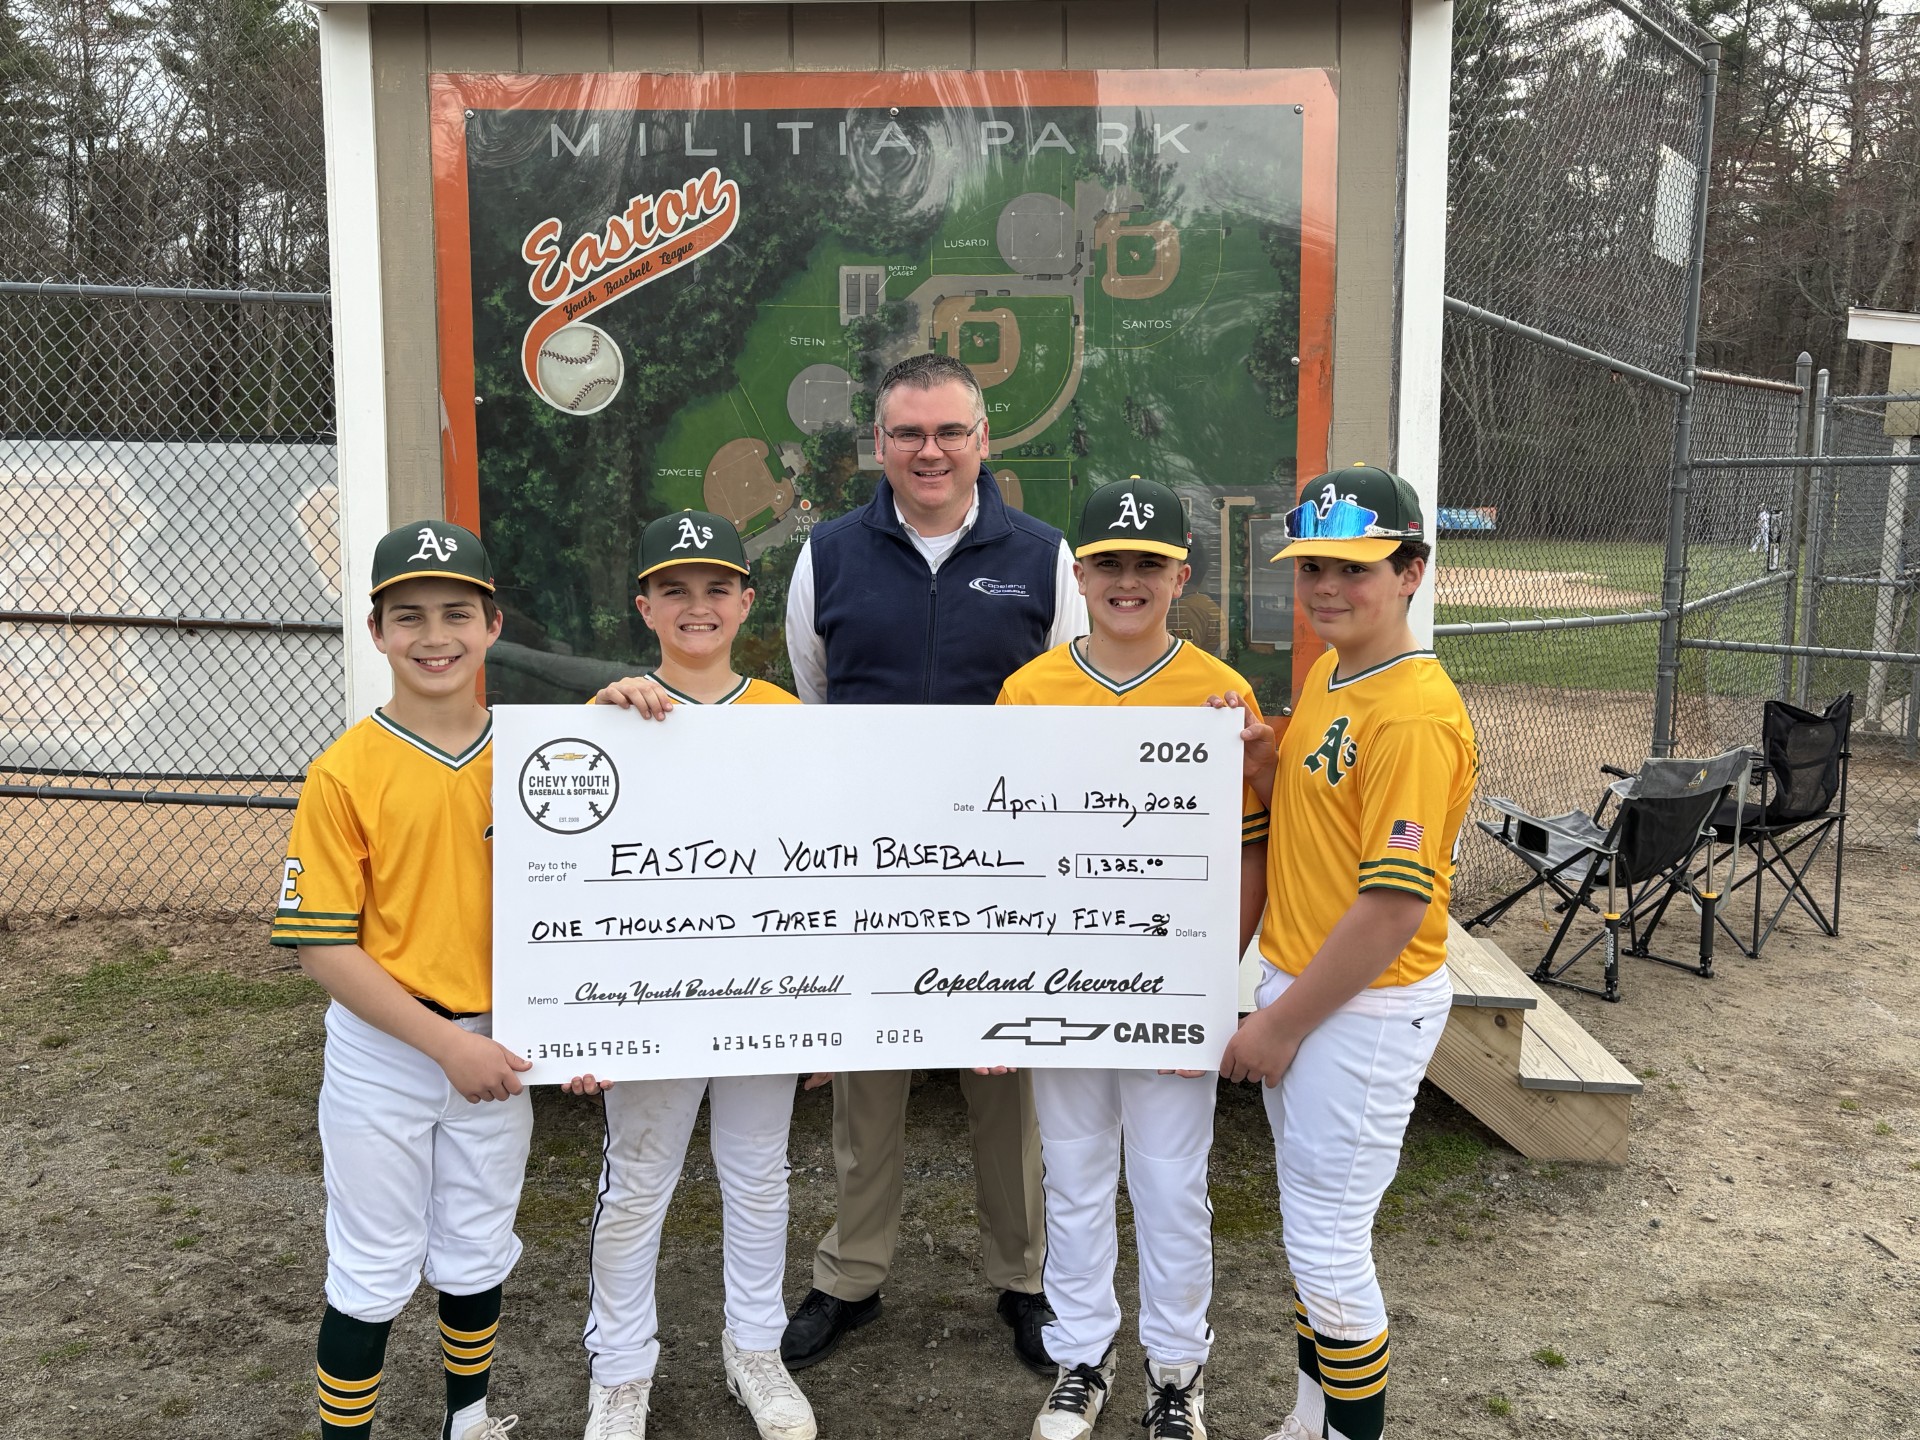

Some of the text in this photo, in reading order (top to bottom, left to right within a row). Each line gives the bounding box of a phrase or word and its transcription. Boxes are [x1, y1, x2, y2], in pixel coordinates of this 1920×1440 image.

[550, 120, 1191, 158] MILITIA PARK
[521, 166, 740, 306] Easton
[943, 238, 990, 249] LUSARDI
[562, 241, 695, 322] Youth Baseball League
[1121, 318, 1173, 330] SANTOS
[789, 336, 826, 347] STEIN
[987, 402, 1011, 413] LEY
[657, 468, 703, 478] JAYCEE
[794, 515, 820, 524] YOU
[794, 524, 813, 533] AR
[981, 581, 1026, 590] Copeland
[1139, 742, 1209, 763] 2026
[528, 775, 610, 788] CHEVY YOUTH
[528, 788, 609, 796] BASEBALL & SOFTBALL
[953, 803, 975, 813] Date
[987, 775, 1198, 828] April 13th, 2026
[610, 836, 1025, 877] EASTON YOUTH BASEBALL
[527, 860, 577, 874] Pay to the
[1057, 856, 1072, 876] $
[527, 872, 567, 882] order of
[531, 920, 583, 941] ONE
[595, 913, 736, 936] THOUSAND
[752, 909, 838, 933] THREE
[853, 908, 971, 932] HUNDRED
[977, 904, 1057, 936] TWENTY
[1175, 928, 1208, 938] Dollars
[913, 967, 1164, 997] Copeland Chevrolet
[574, 981, 628, 1004] Chevy
[628, 979, 684, 1007] Youth
[684, 976, 761, 998] Baseball
[777, 974, 845, 999] Softball
[527, 996, 559, 1005] Memo
[1113, 1022, 1205, 1044] CARES
[712, 1031, 843, 1051] 1234567890
[875, 1029, 924, 1044] 2026
